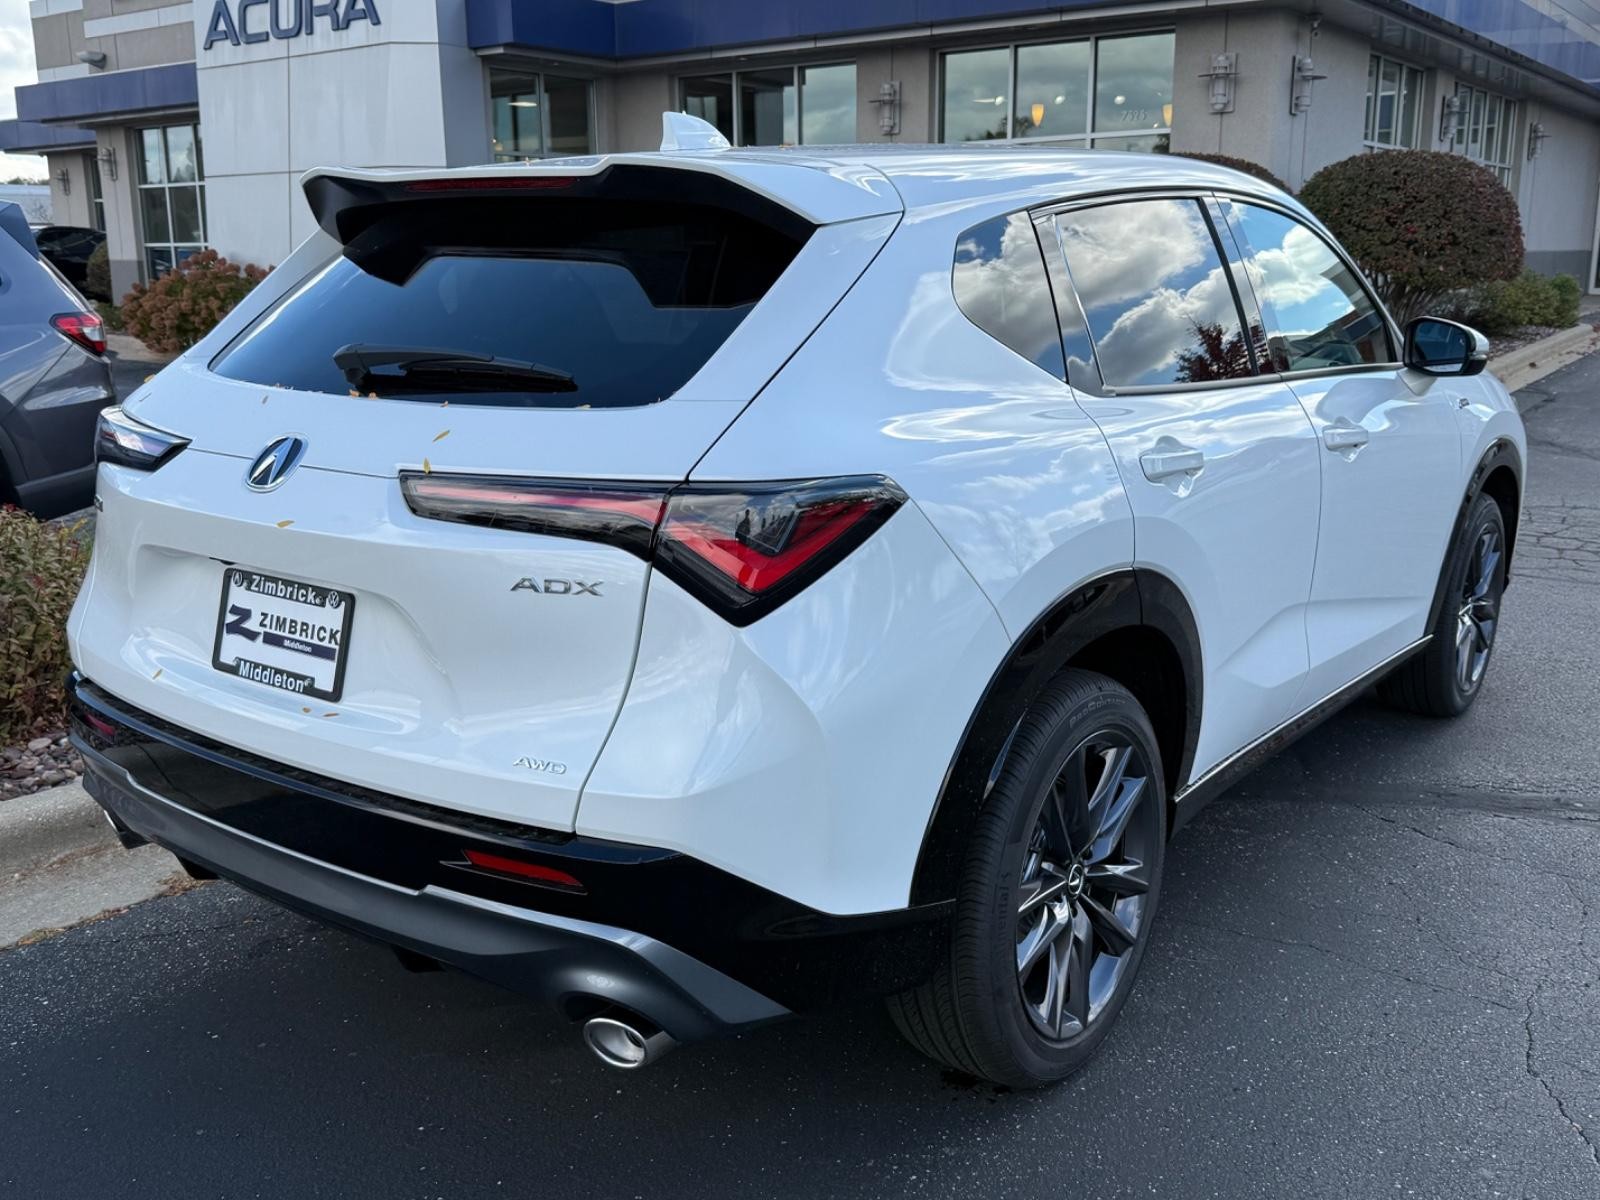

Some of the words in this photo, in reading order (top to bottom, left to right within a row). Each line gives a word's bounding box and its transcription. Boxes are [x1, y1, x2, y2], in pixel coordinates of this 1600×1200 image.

[203, 0, 381, 50] ACURA
[251, 575, 317, 605] Zimbrick
[510, 577, 604, 597] ADX
[259, 611, 341, 646] ZIMBRICK
[283, 639, 313, 653] Middleton
[239, 660, 305, 693] Middleton
[512, 756, 567, 775] AWD
